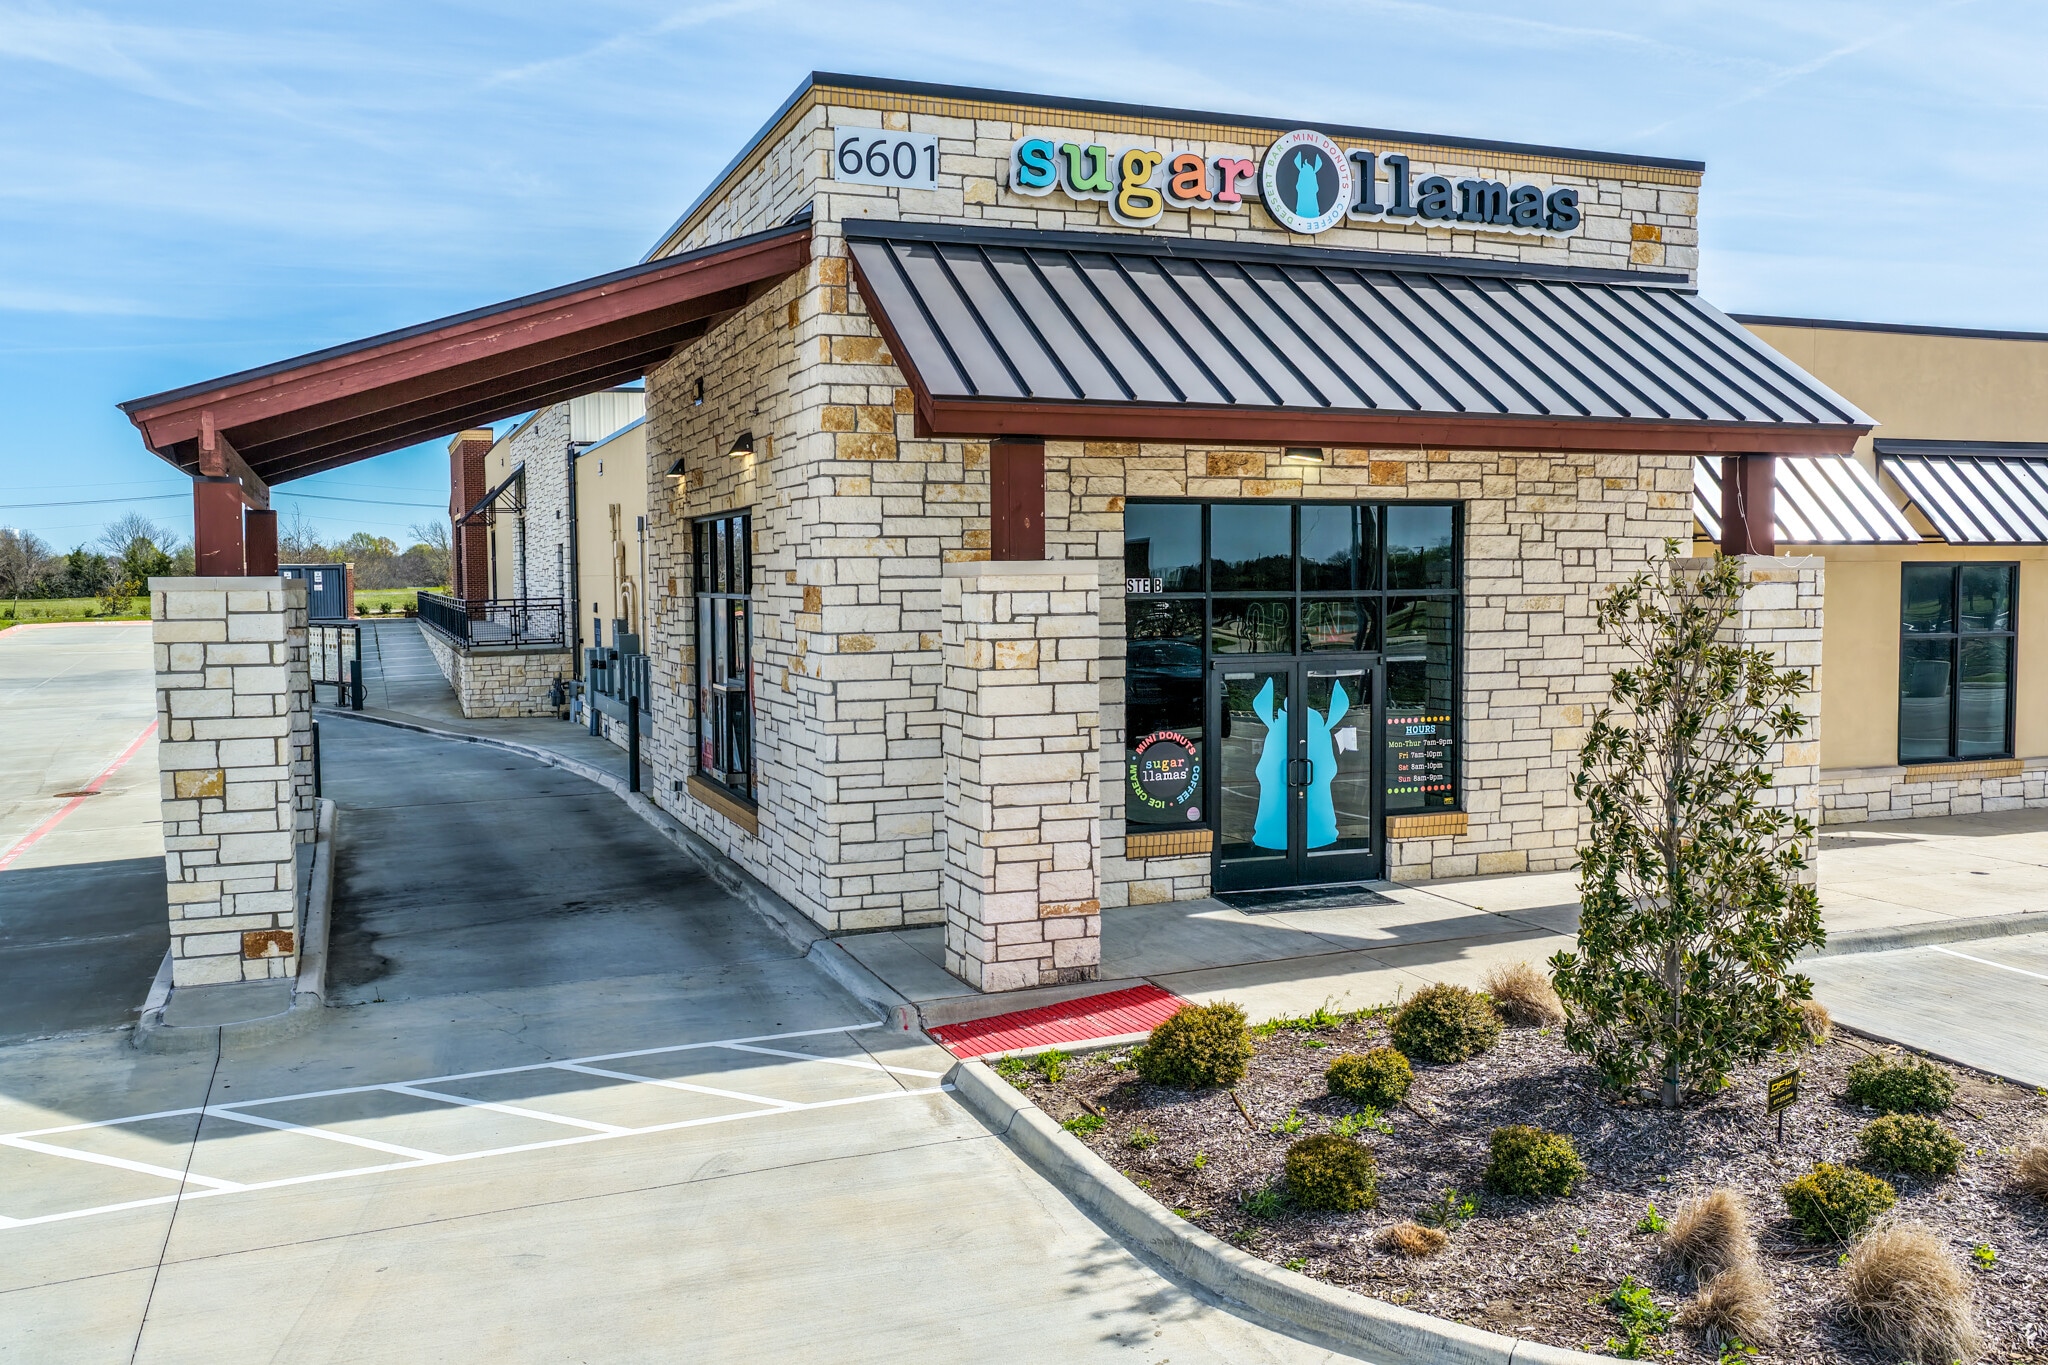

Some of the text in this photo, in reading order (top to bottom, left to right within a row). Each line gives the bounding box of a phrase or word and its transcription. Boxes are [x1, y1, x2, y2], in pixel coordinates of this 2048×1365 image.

[838, 136, 936, 183] 6601
[1292, 133, 1349, 189] MINI DONUTS
[1018, 138, 1581, 232] sugar llamas
[1265, 144, 1294, 225] DESSERT BAR
[1306, 203, 1344, 230] COFFEE
[1127, 579, 1162, 593] STE B
[1405, 725, 1436, 735] HOURS
[1135, 731, 1197, 756] MINI DONUTS
[1388, 740, 1421, 748] Mon-Thur
[1142, 771, 1187, 782] llamas
[1145, 759, 1185, 771] sugar
[1129, 764, 1165, 809] ICE CREAM
[1176, 765, 1200, 805] COFFEE
[1770, 1076, 1793, 1093] DFW
